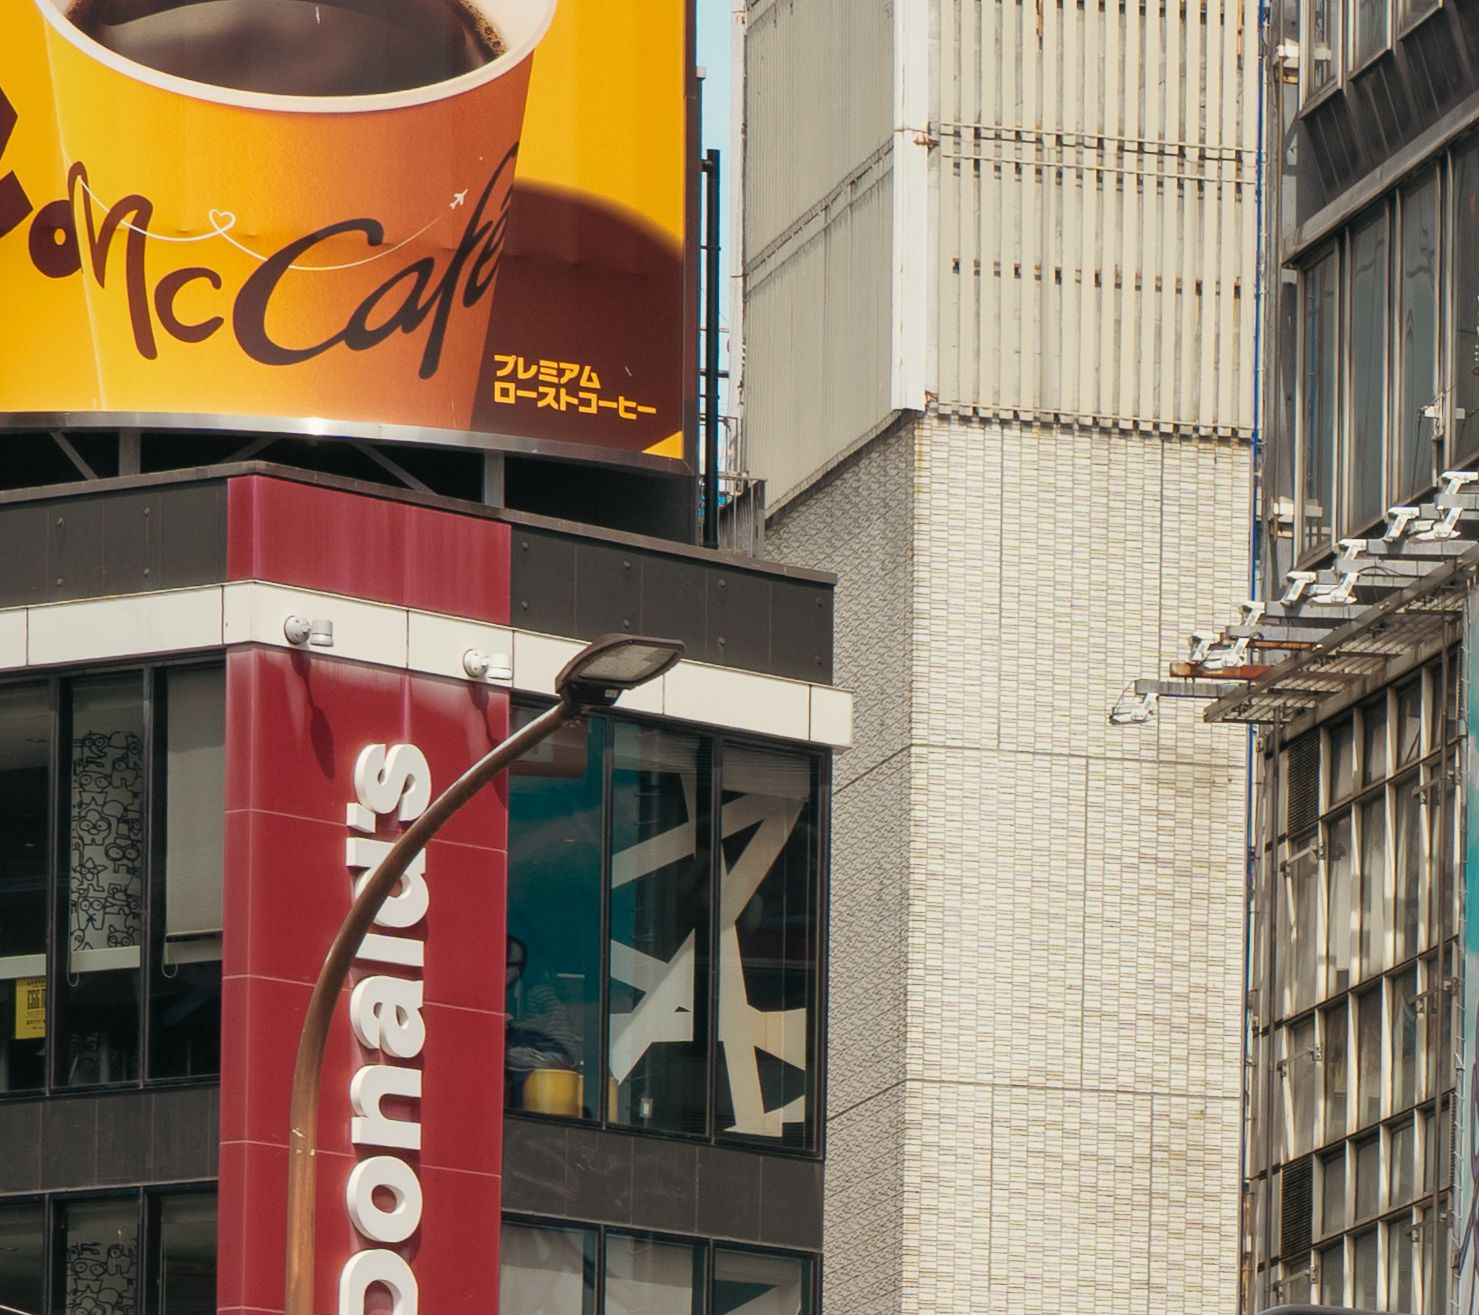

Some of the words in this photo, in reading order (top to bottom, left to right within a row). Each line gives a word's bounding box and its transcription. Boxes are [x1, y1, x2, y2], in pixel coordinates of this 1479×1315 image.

[494, 354, 602, 390] プレミアム
[494, 382, 657, 419] ローストコーヒー
